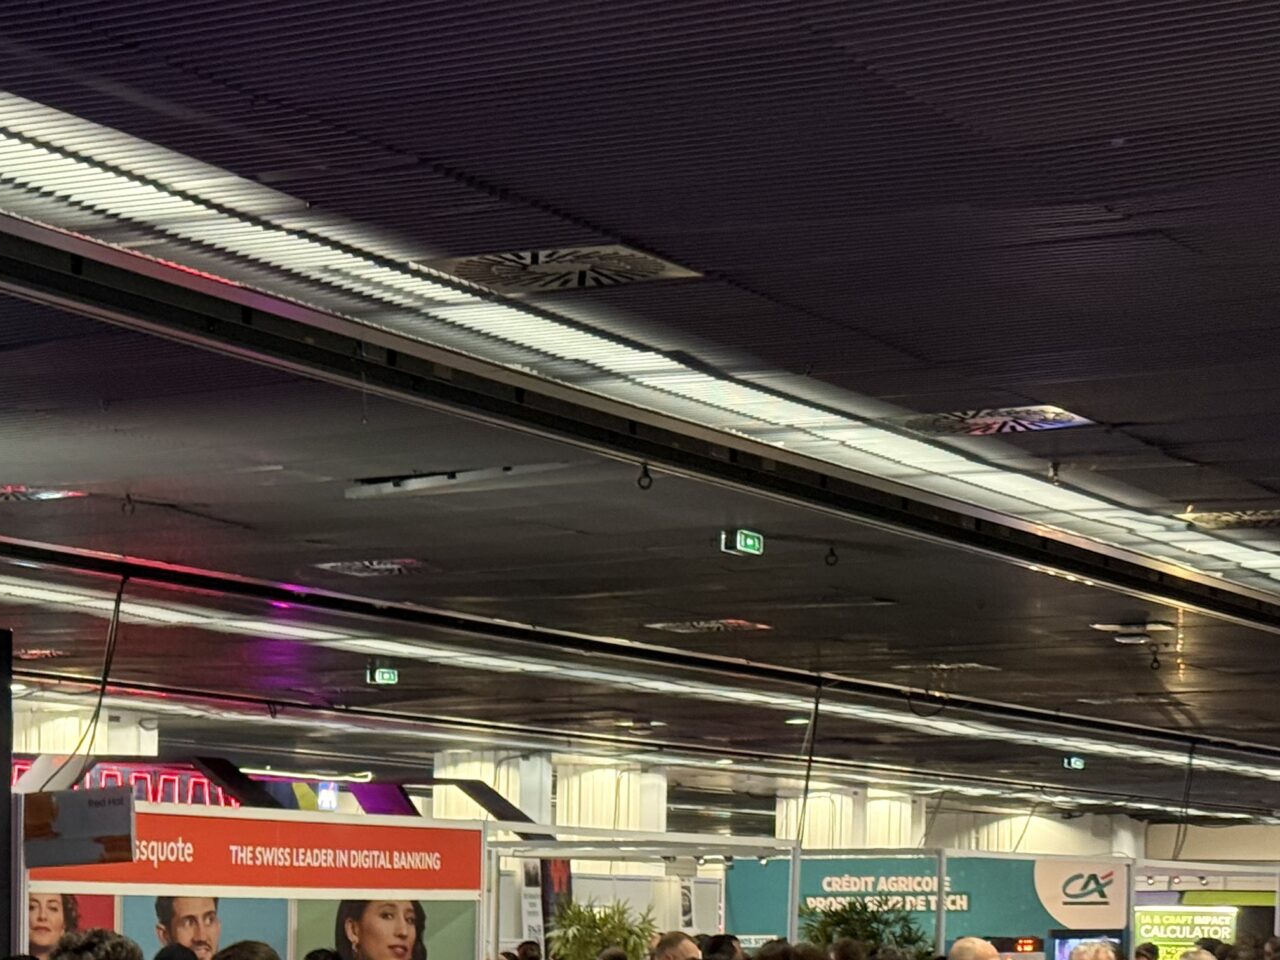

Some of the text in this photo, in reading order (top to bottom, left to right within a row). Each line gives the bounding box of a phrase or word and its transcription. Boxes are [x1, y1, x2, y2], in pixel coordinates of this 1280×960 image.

[229, 845, 441, 871] THE SWISS LEADER IN DIGITAL BANKING
[822, 874, 875, 892] CRÉDIT
[905, 895, 927, 911] DE
[928, 895, 968, 911] TCH
[1140, 925, 1231, 939] CALCULATOR
